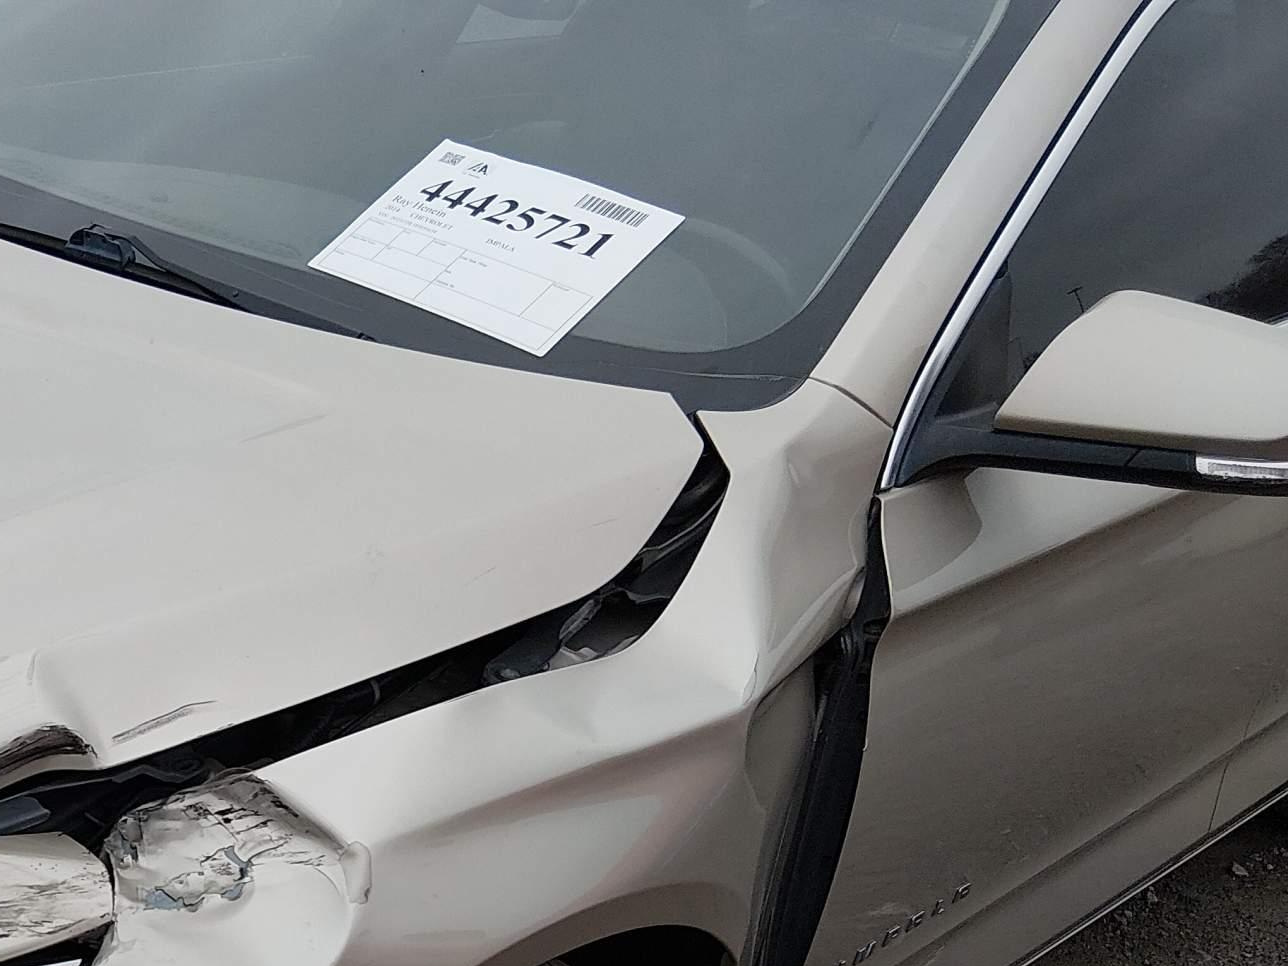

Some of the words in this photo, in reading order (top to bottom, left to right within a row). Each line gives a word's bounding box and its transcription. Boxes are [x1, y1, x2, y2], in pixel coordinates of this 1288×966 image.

[392, 194, 410, 208] Ray
[420, 179, 616, 259] 44425721
[410, 212, 454, 231] CHEVROLET
[485, 238, 516, 252] IMPALA
